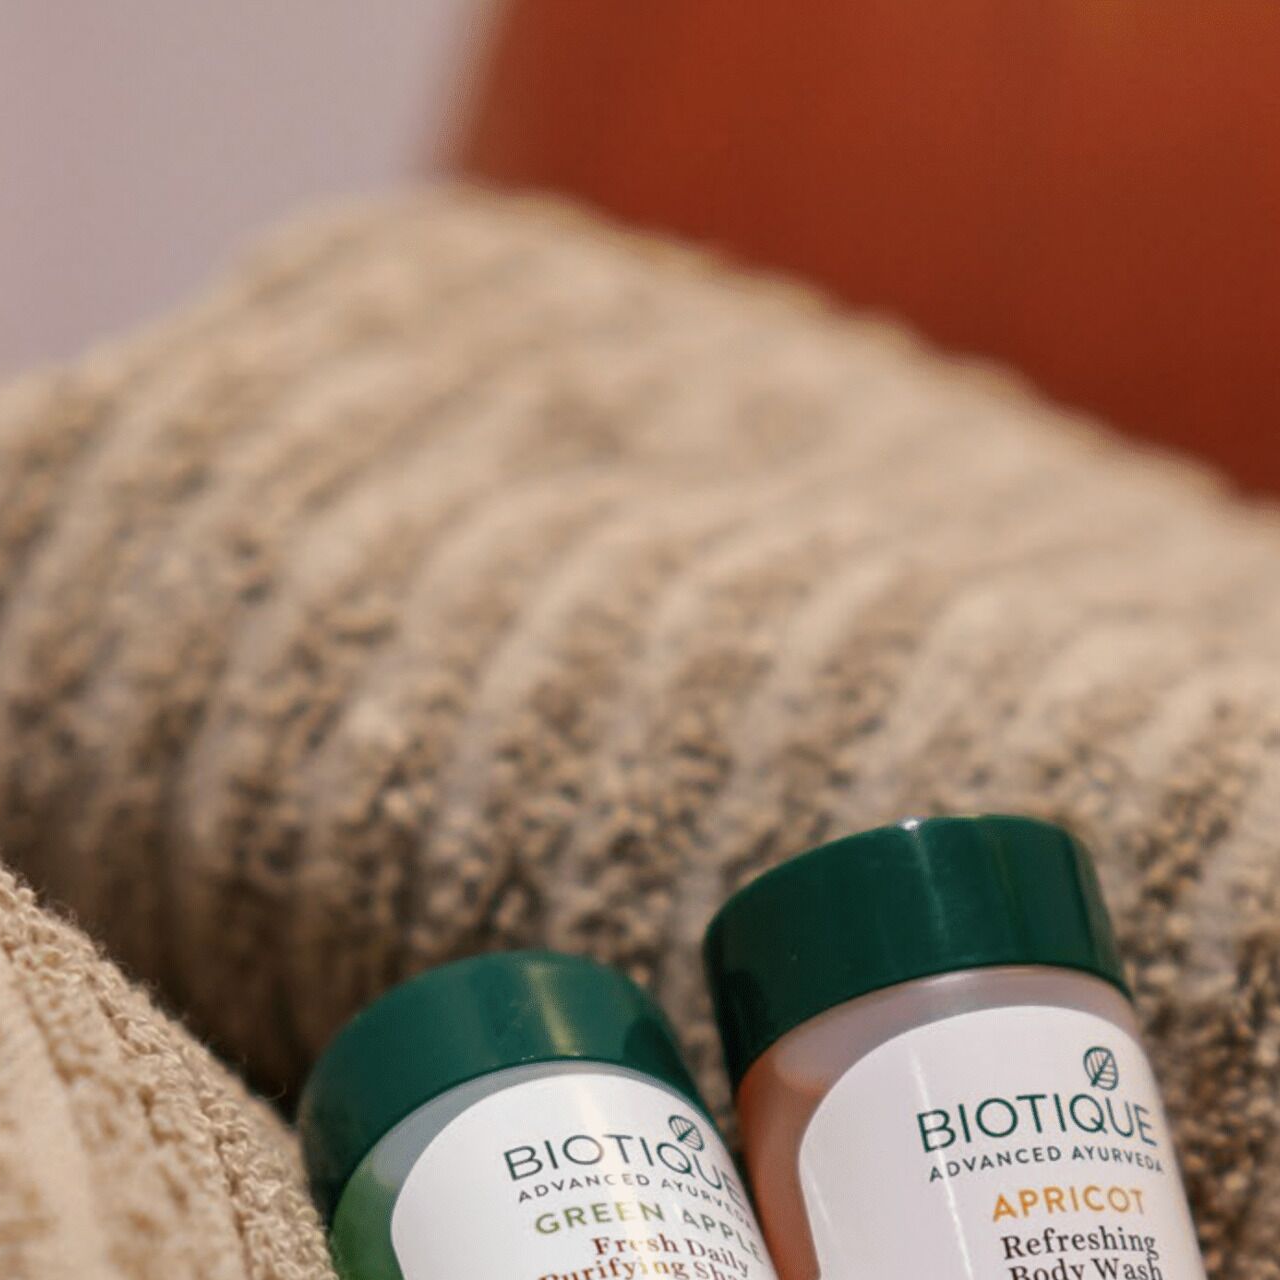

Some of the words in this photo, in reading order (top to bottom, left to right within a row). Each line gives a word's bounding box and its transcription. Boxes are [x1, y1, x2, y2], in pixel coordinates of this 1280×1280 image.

[916, 1092, 1158, 1153] BIOTIQUE
[503, 1133, 746, 1209] BIOTIQUE
[928, 1144, 1062, 1183] ADVANCED
[1071, 1145, 1163, 1173] AYURVEDA
[518, 1172, 650, 1203] ADVANCED
[992, 1184, 1145, 1223] APRICOT
[534, 1201, 666, 1235] GREEN
[681, 1208, 764, 1264] APPLE
[1000, 1225, 1159, 1261] Refreshing
[591, 1232, 679, 1256] Fresh
[684, 1238, 749, 1278] Daily
